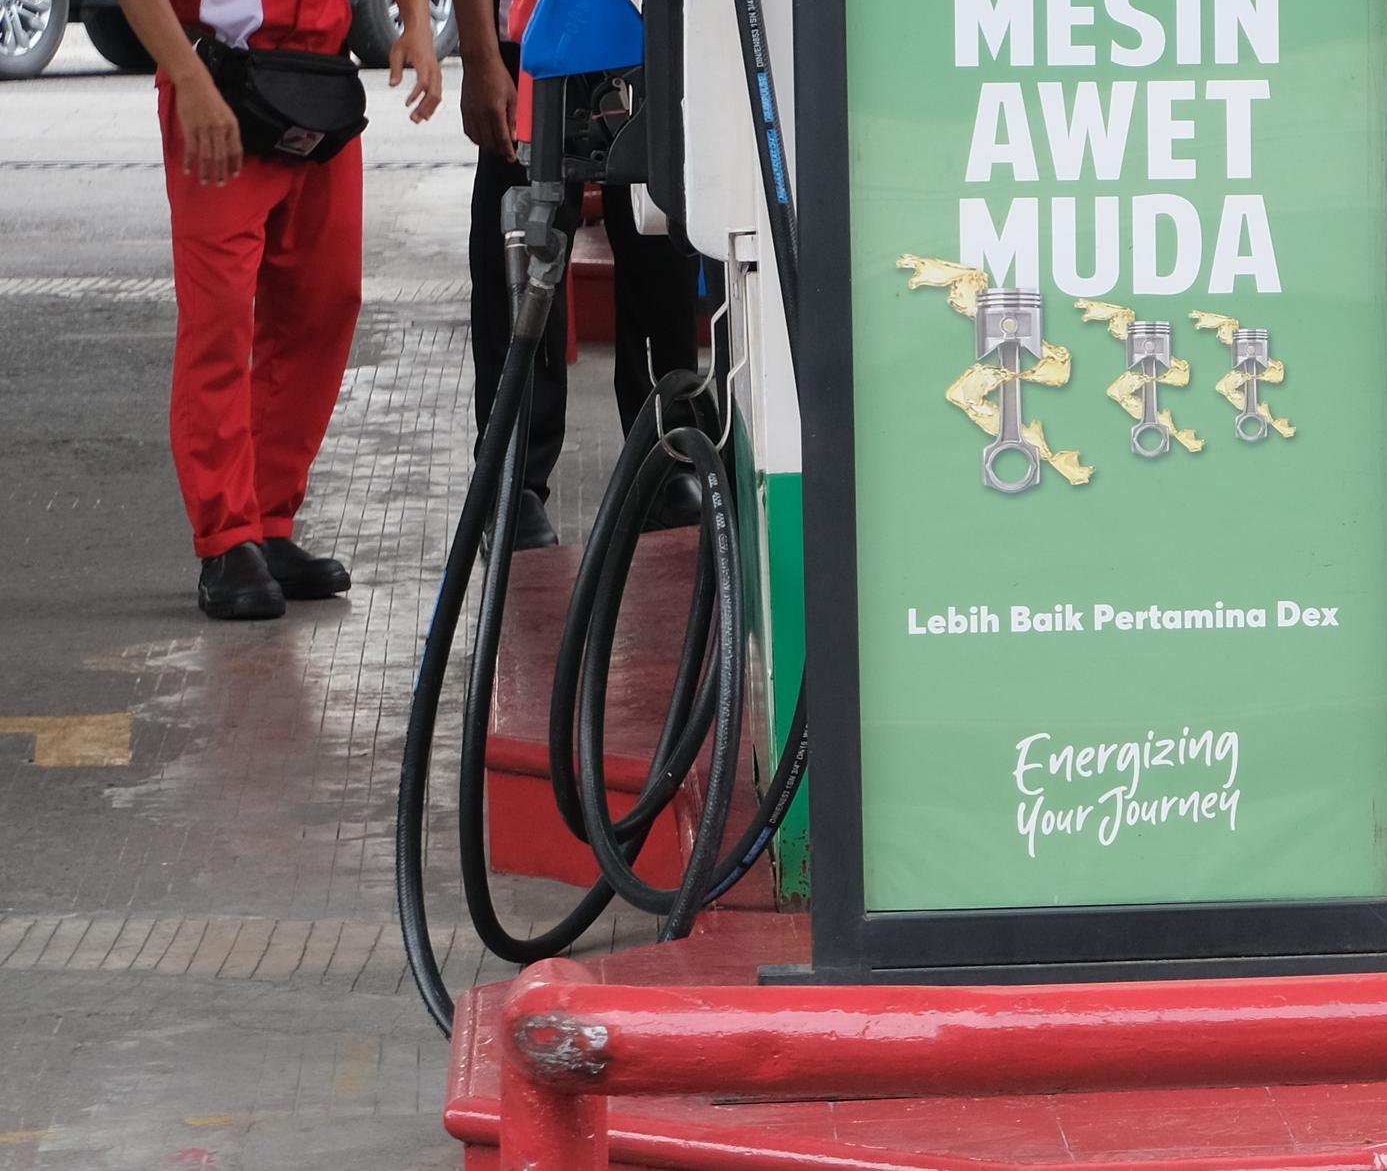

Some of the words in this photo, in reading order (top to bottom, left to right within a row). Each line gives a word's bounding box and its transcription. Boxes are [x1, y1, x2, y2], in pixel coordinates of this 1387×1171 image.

[965, 79, 1272, 182] AWET
[959, 193, 1282, 297] MUDA
[907, 605, 1000, 635] Lebih
[1010, 604, 1085, 633] Baik
[1094, 601, 1267, 631] Pertamina
[1277, 600, 1340, 628] Dex
[1012, 726, 1239, 800] Energizing
[1016, 795, 1095, 859] Your
[1097, 785, 1242, 847] Journey
